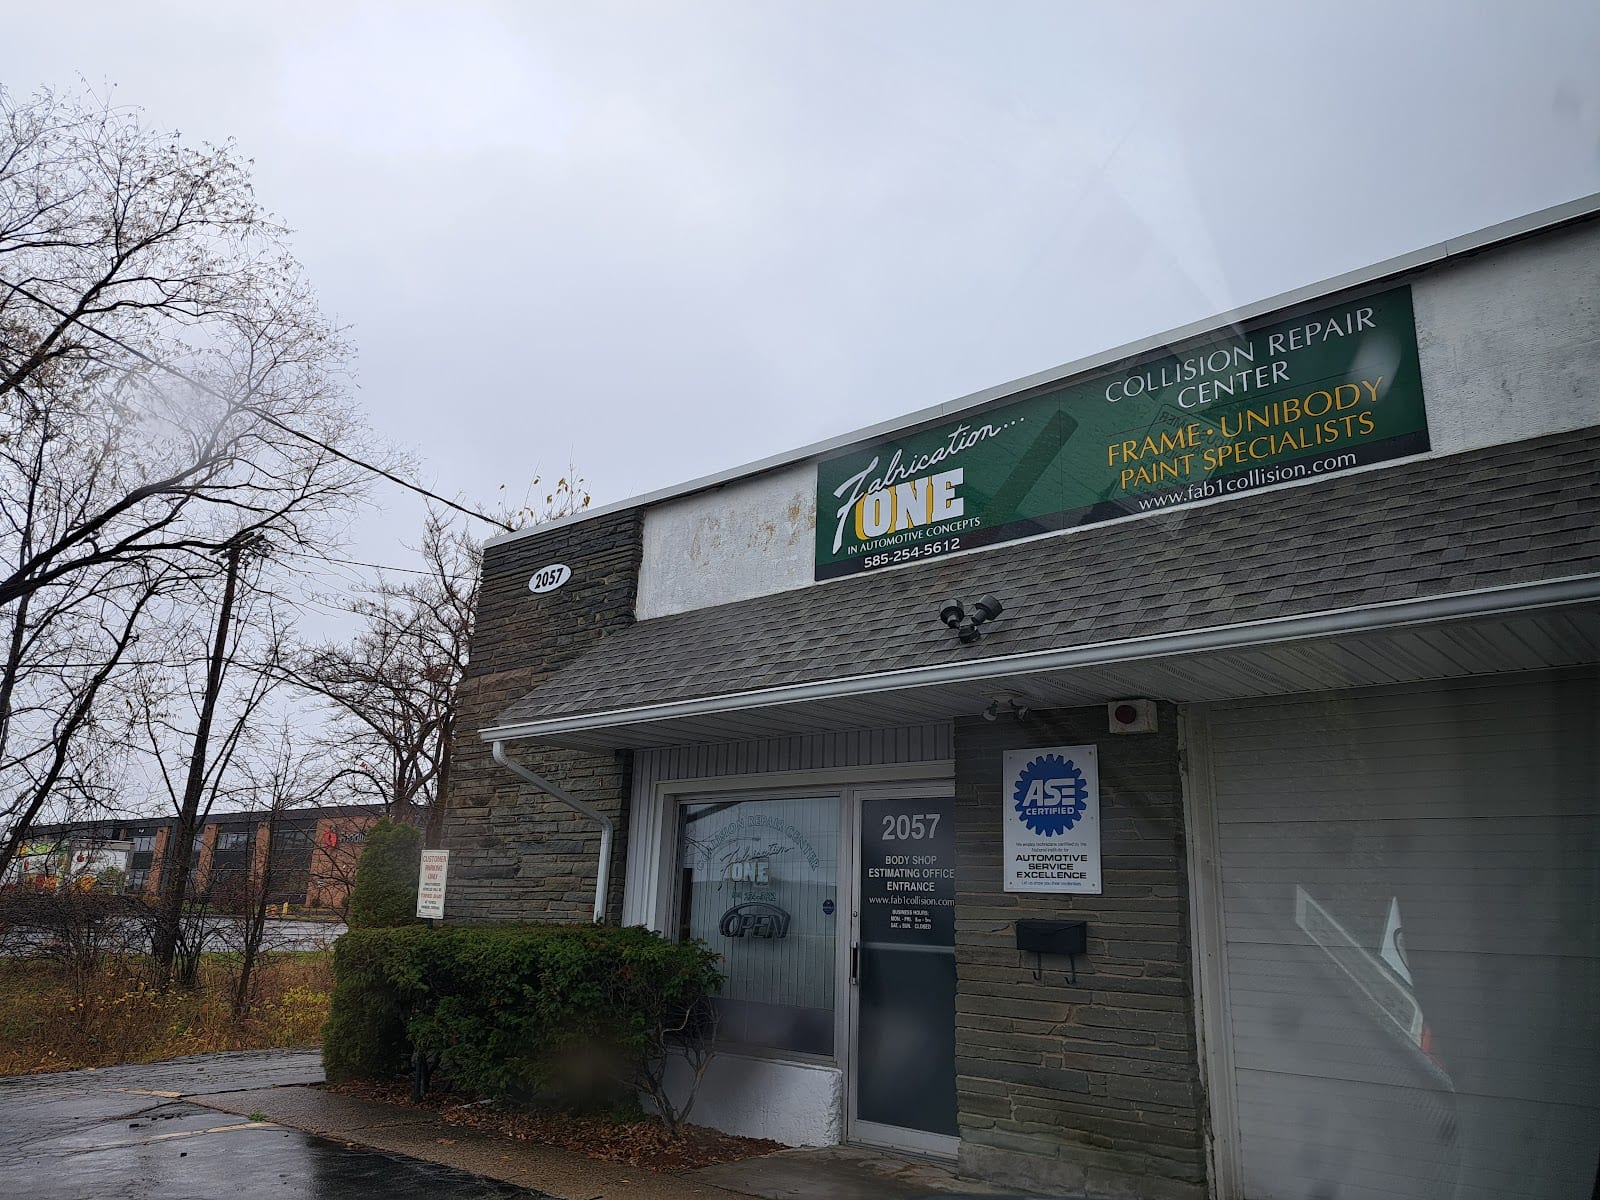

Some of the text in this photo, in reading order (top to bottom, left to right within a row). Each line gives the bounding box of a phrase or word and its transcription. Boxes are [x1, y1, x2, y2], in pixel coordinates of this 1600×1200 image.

[1105, 307, 1377, 403] COLLISION REPAIR
[1178, 361, 1290, 409] CENTER
[1107, 422, 1200, 467] FRAME
[1219, 376, 1383, 438] UNIBODY
[1120, 453, 1195, 490] PAINT
[1202, 411, 1375, 471] SPECIALISTS
[1138, 452, 1357, 511] www.fab1collision.com
[855, 467, 964, 541] ONE
[847, 516, 981, 555] IN AUTOMOTIVE CONCEPTS
[864, 538, 961, 569] 585-254-5612
[534, 567, 564, 590] 2057
[1022, 778, 1076, 807] ASE
[1025, 807, 1075, 816] CERTIFIED
[881, 813, 941, 841] 2057
[747, 815, 785, 833] REPAIR
[785, 825, 820, 872] CENTER
[885, 855, 937, 865] BODY SHOP
[1015, 854, 1088, 862] AUTOMOTIVE
[1028, 863, 1074, 871] SERVICE
[730, 861, 769, 886] ONE
[868, 868, 955, 879] ESTIMATING OFFICE
[886, 881, 935, 892] ENTRANCE
[1016, 871, 1087, 879] EXCELLENCE
[868, 895, 955, 907] www.fab1collision.com
[720, 912, 791, 939] OPEN
